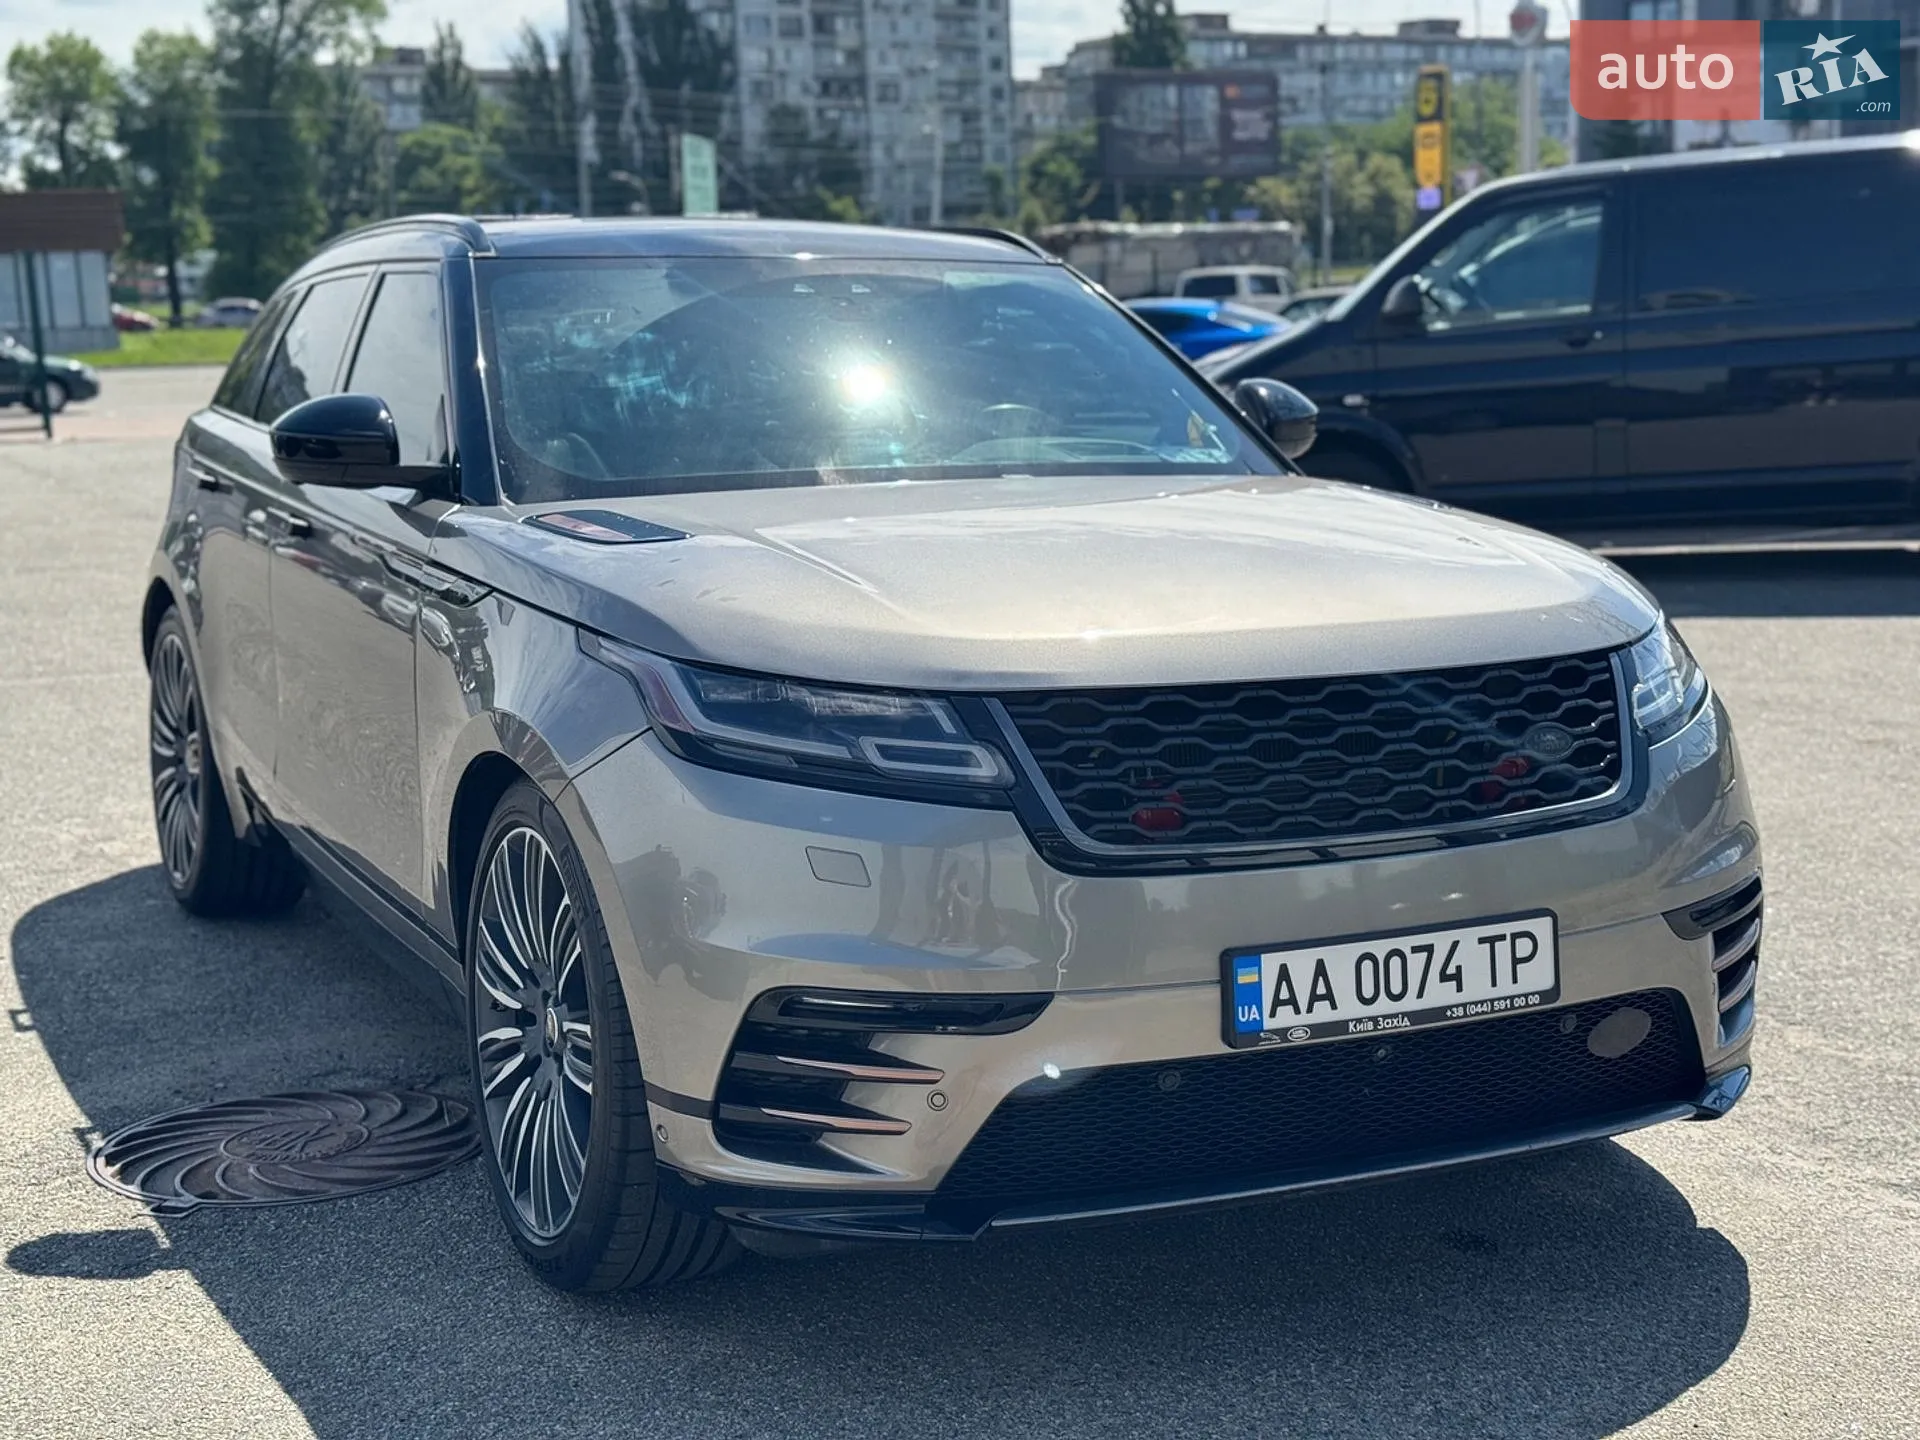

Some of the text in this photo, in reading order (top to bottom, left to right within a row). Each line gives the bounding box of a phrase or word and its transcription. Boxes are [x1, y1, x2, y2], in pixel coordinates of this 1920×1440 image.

[1268, 930, 1539, 1019] AA 0074 TP
[1237, 1004, 1261, 1023] UA
[1445, 994, 1540, 1018] +38 (044) 591 00 00
[1348, 1014, 1411, 1033] Київ Захід
